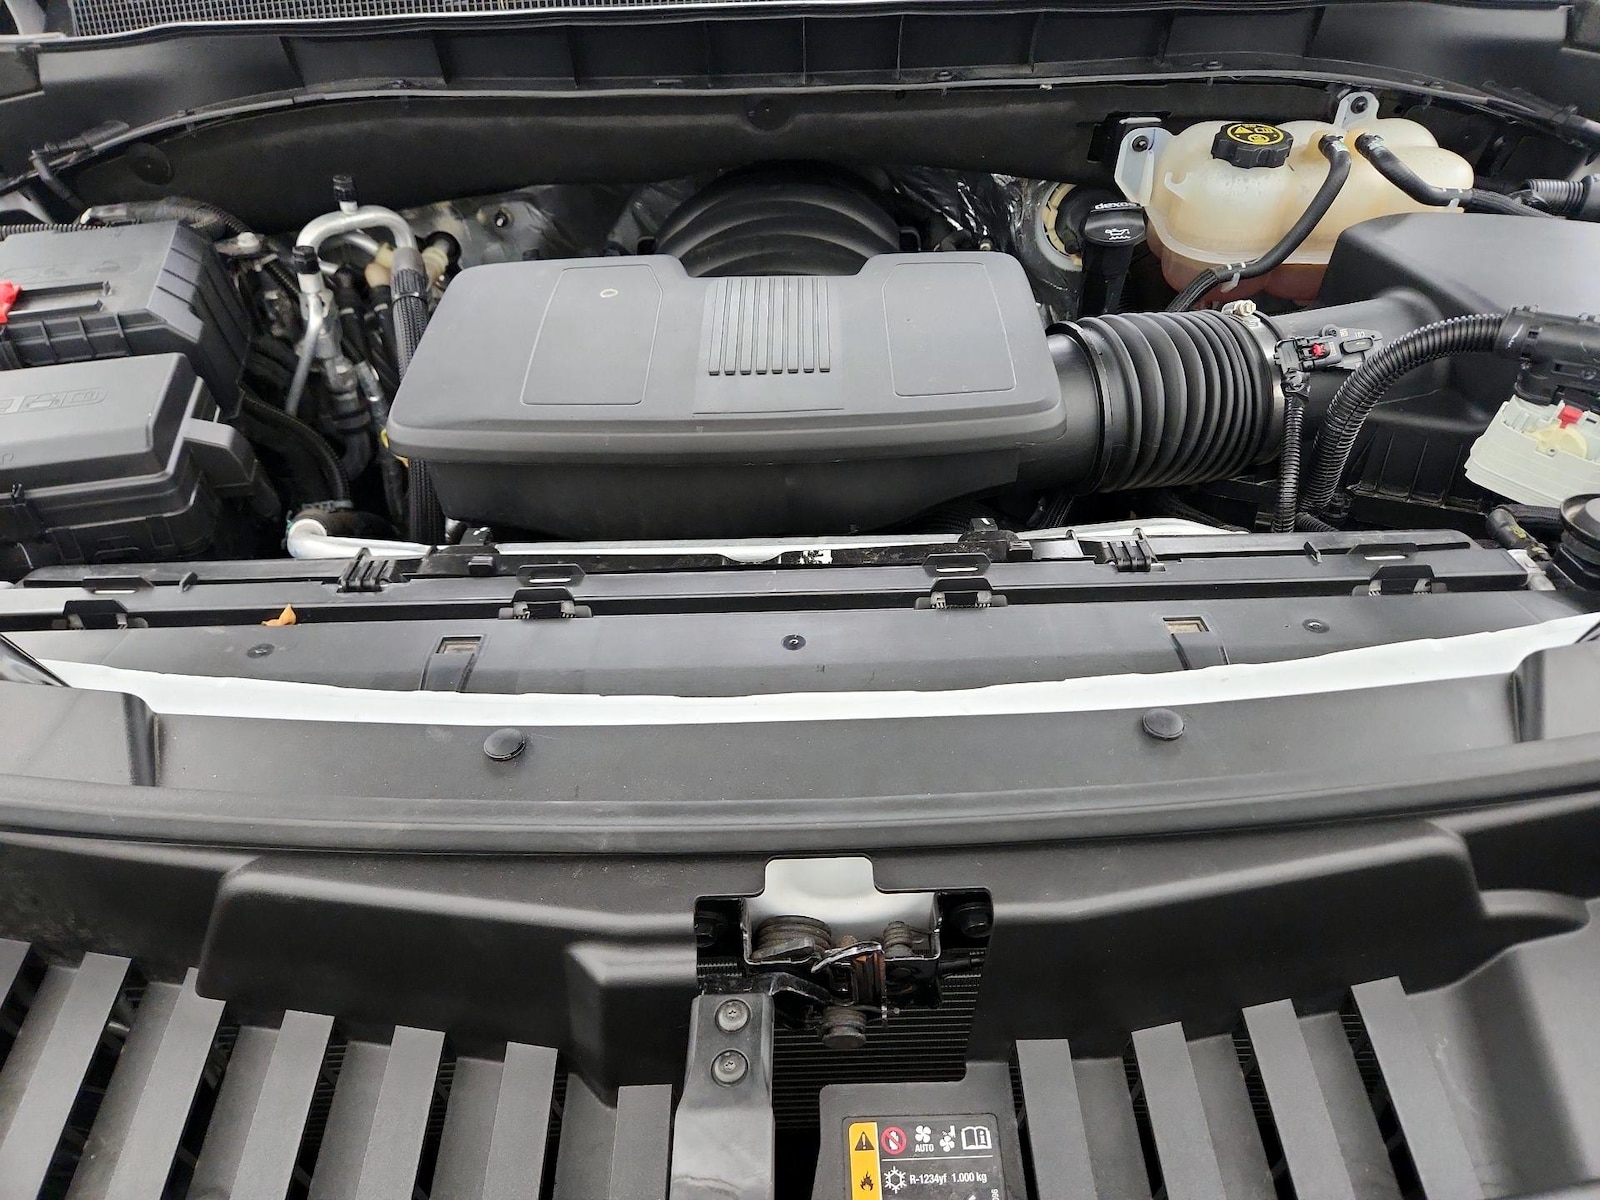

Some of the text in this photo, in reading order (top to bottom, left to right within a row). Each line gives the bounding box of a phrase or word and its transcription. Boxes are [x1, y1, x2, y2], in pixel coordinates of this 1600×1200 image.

[915, 1144, 935, 1152] AUTO
[910, 1172, 988, 1185] R-1234yf 1.000 kg
